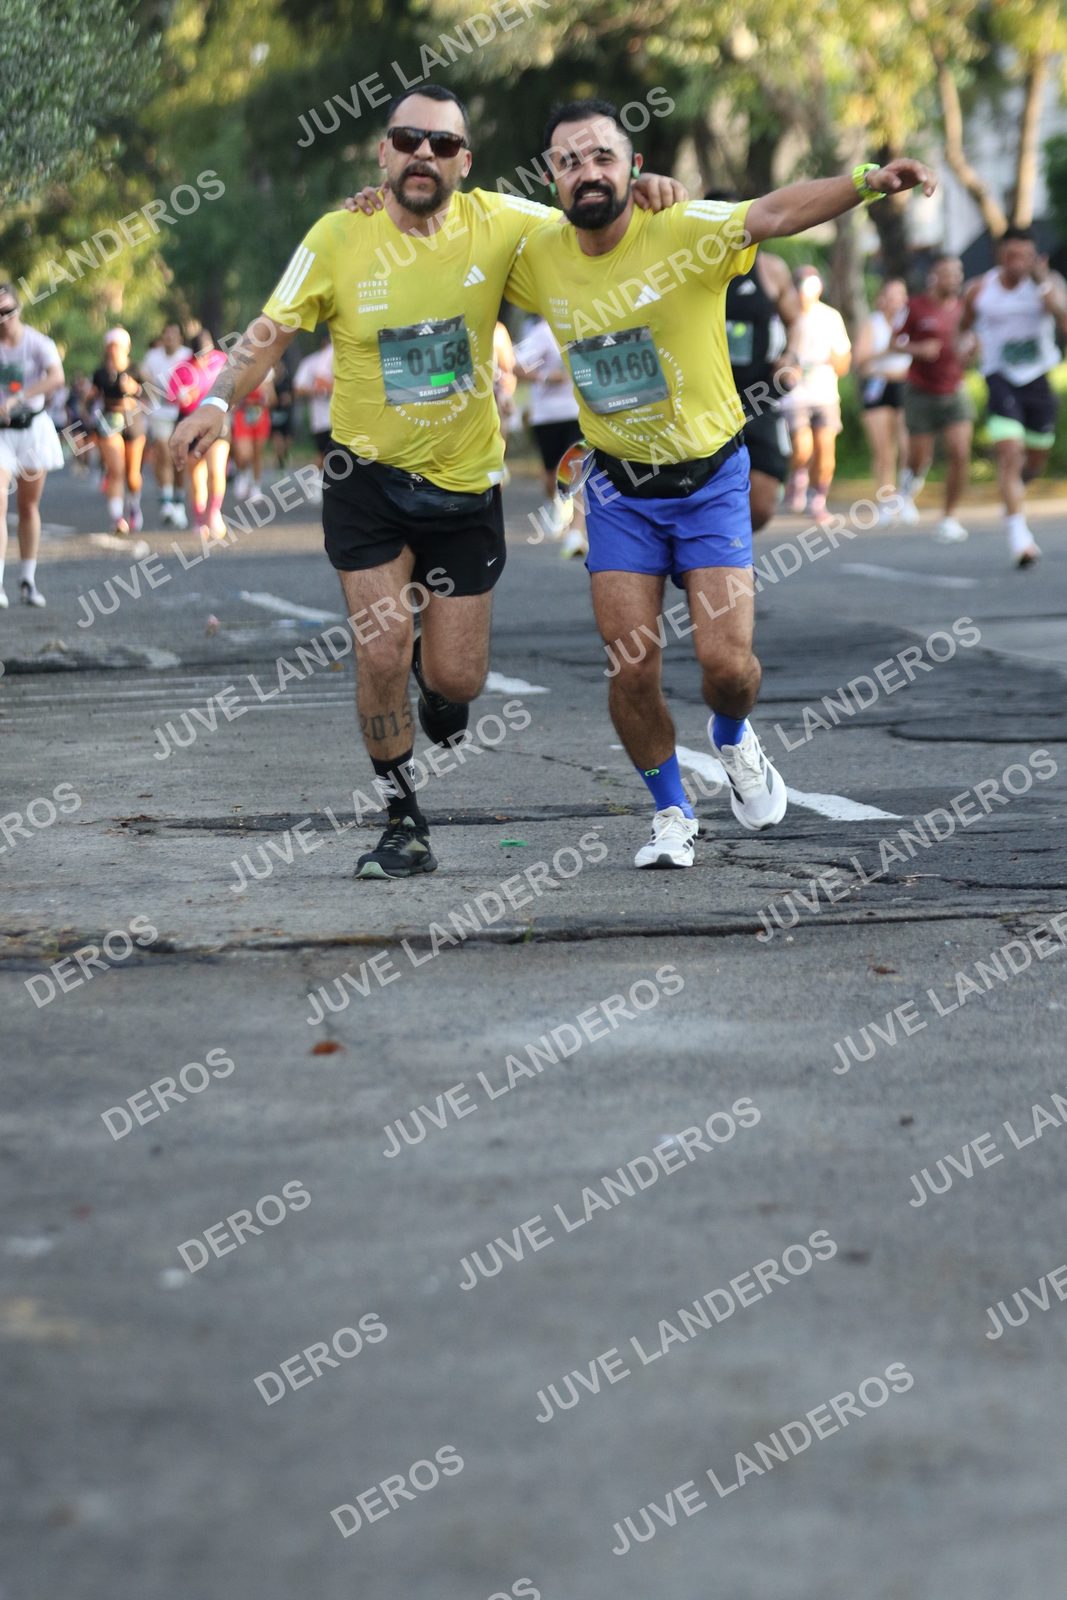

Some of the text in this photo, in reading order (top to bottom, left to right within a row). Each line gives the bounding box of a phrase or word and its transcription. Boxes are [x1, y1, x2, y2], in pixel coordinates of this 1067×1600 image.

[407, 338, 470, 376] 0158
[595, 349, 659, 387] 0160
[419, 387, 449, 397] SAMSUNG
[607, 396, 638, 408] SAMSUNG
